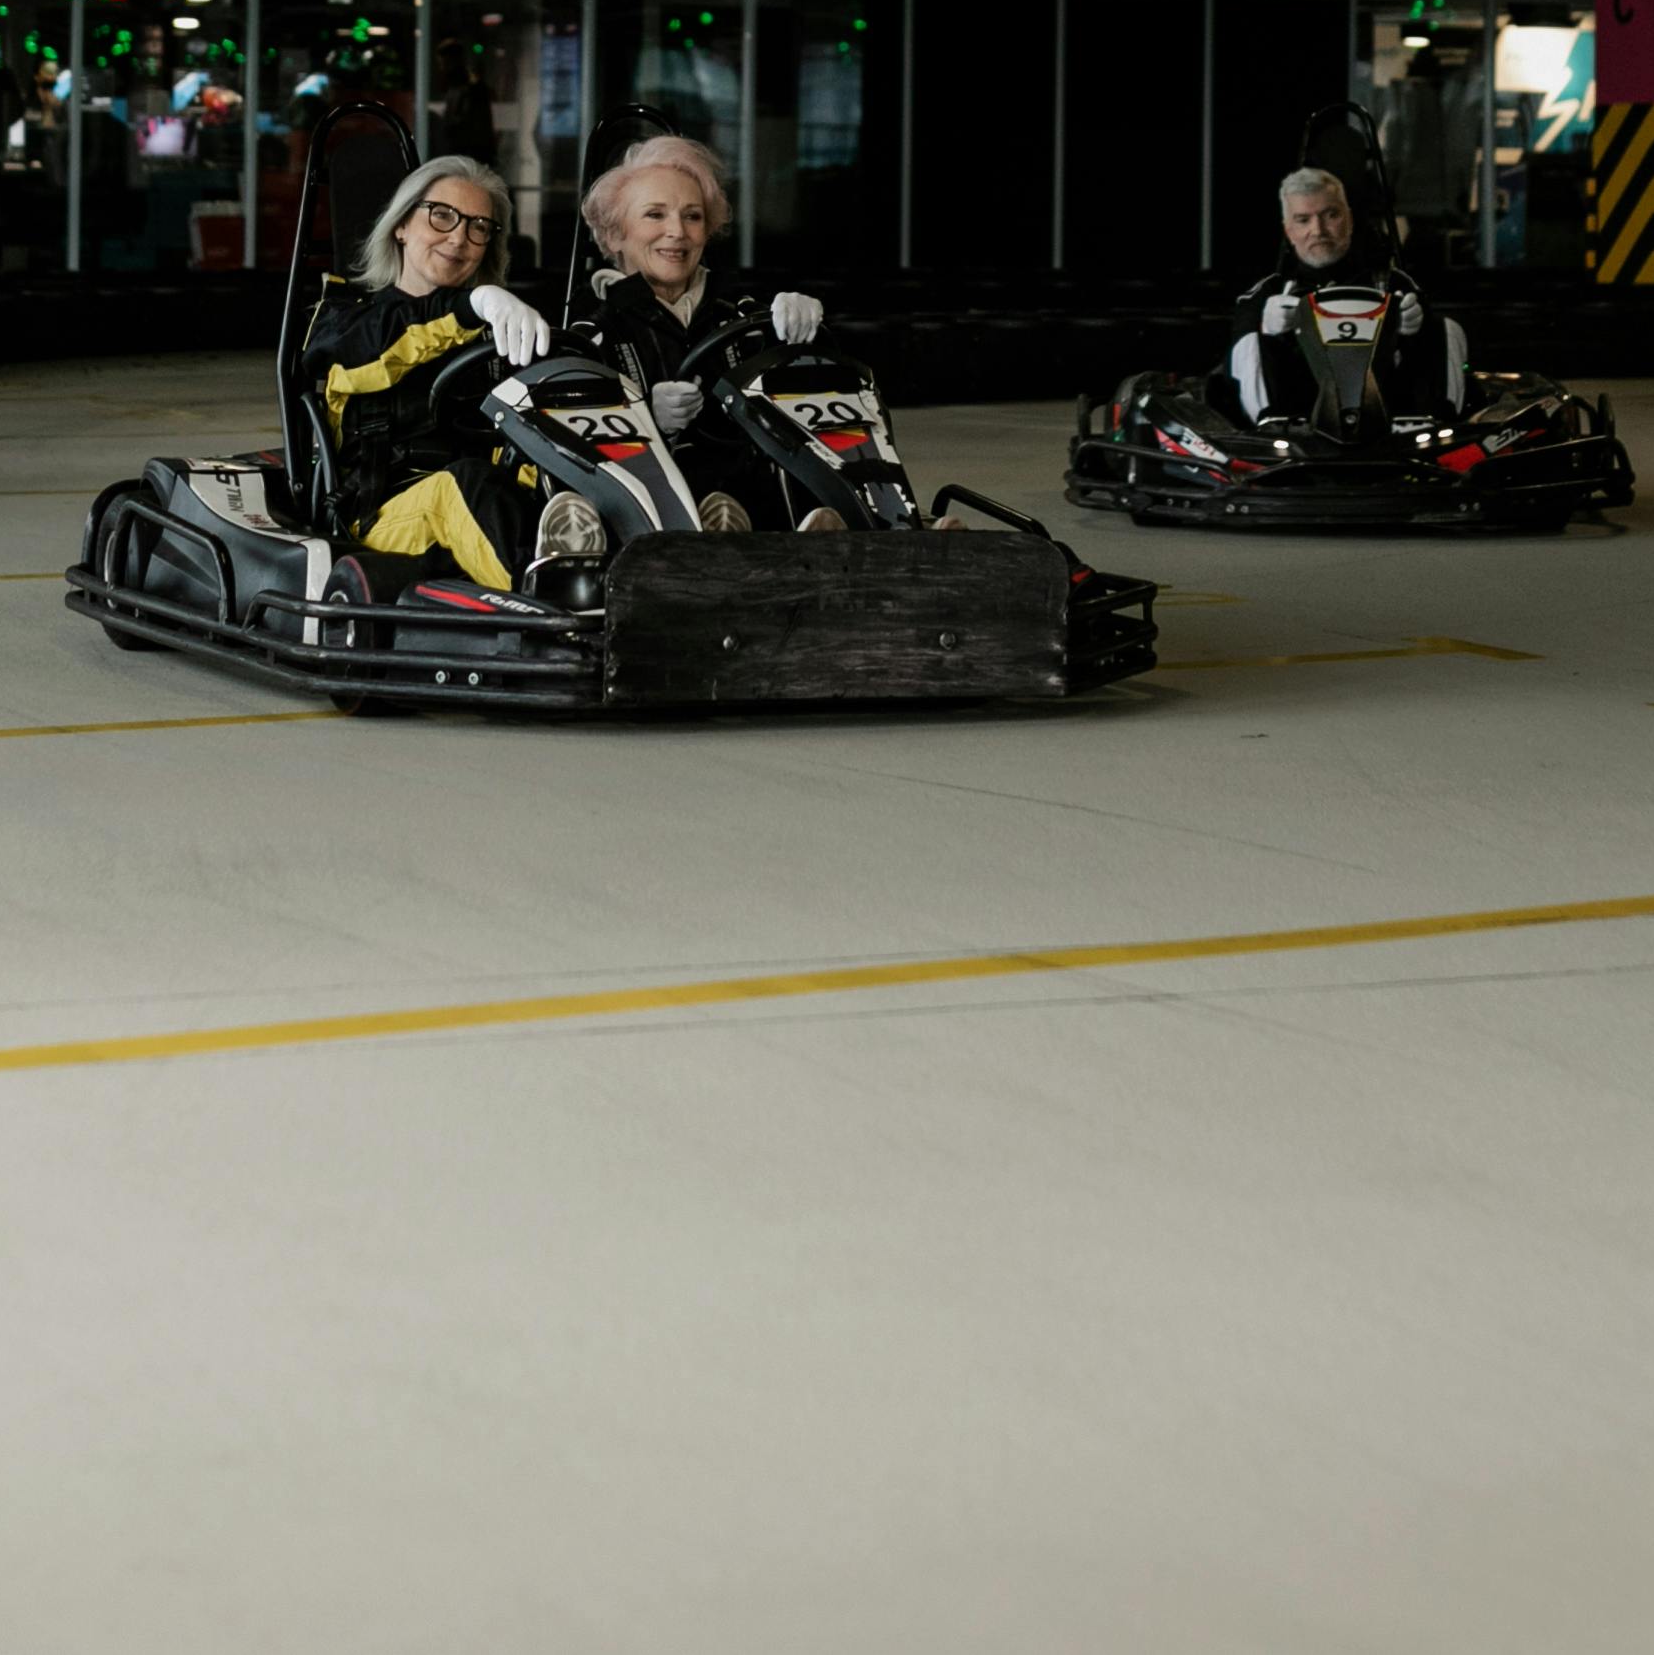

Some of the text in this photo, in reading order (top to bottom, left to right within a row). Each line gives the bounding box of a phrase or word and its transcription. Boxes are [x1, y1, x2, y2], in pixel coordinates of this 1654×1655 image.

[1338, 321, 1356, 340] 9
[793, 400, 865, 428] 20
[568, 414, 640, 443] 20
